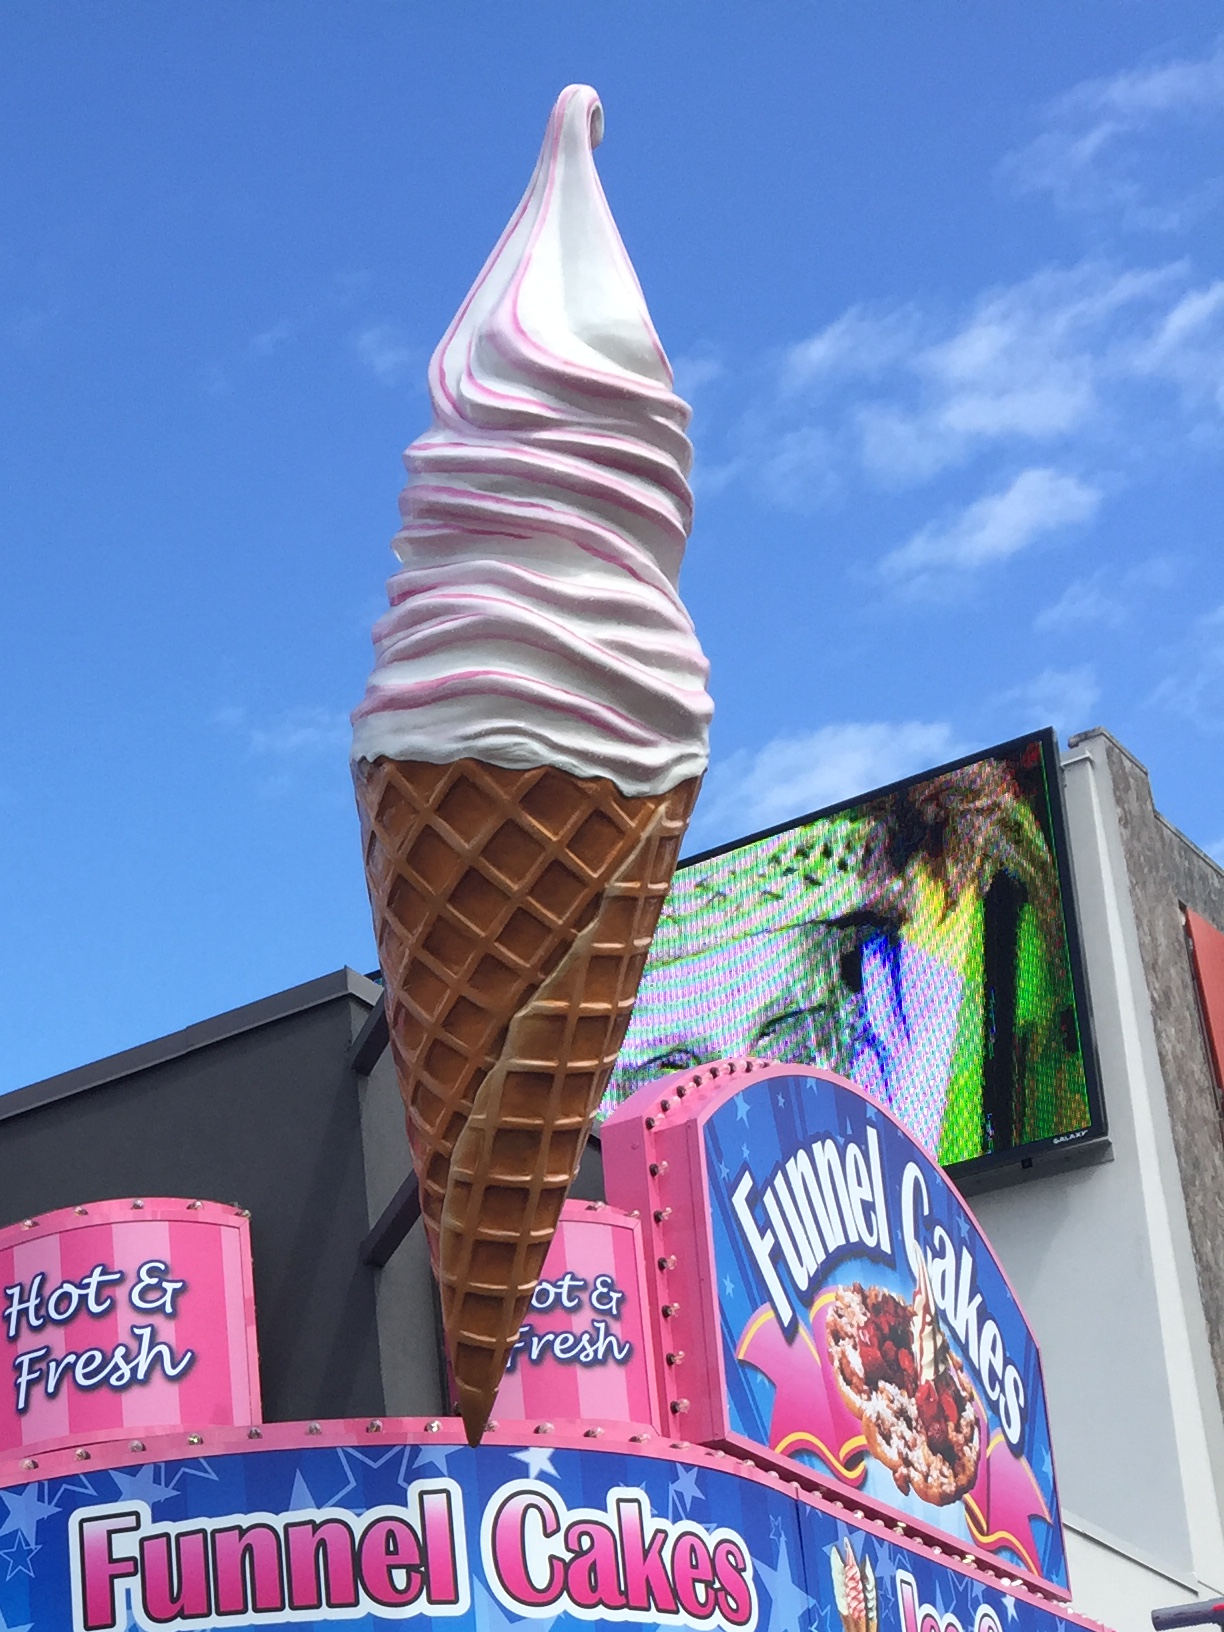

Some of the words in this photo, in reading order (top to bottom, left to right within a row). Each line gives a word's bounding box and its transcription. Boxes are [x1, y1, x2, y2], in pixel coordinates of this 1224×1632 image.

[1052, 1129, 1089, 1145] GALAXY
[3, 1265, 122, 1337] Hot
[130, 1261, 184, 1314] &
[530, 1273, 585, 1309] ot
[590, 1276, 623, 1315] &
[731, 1125, 892, 1328] Funnel
[900, 1161, 1025, 1445] Cakes
[13, 1325, 193, 1410] Fresh
[78, 1488, 460, 1632] Funnel
[490, 1486, 753, 1628] Cakes
